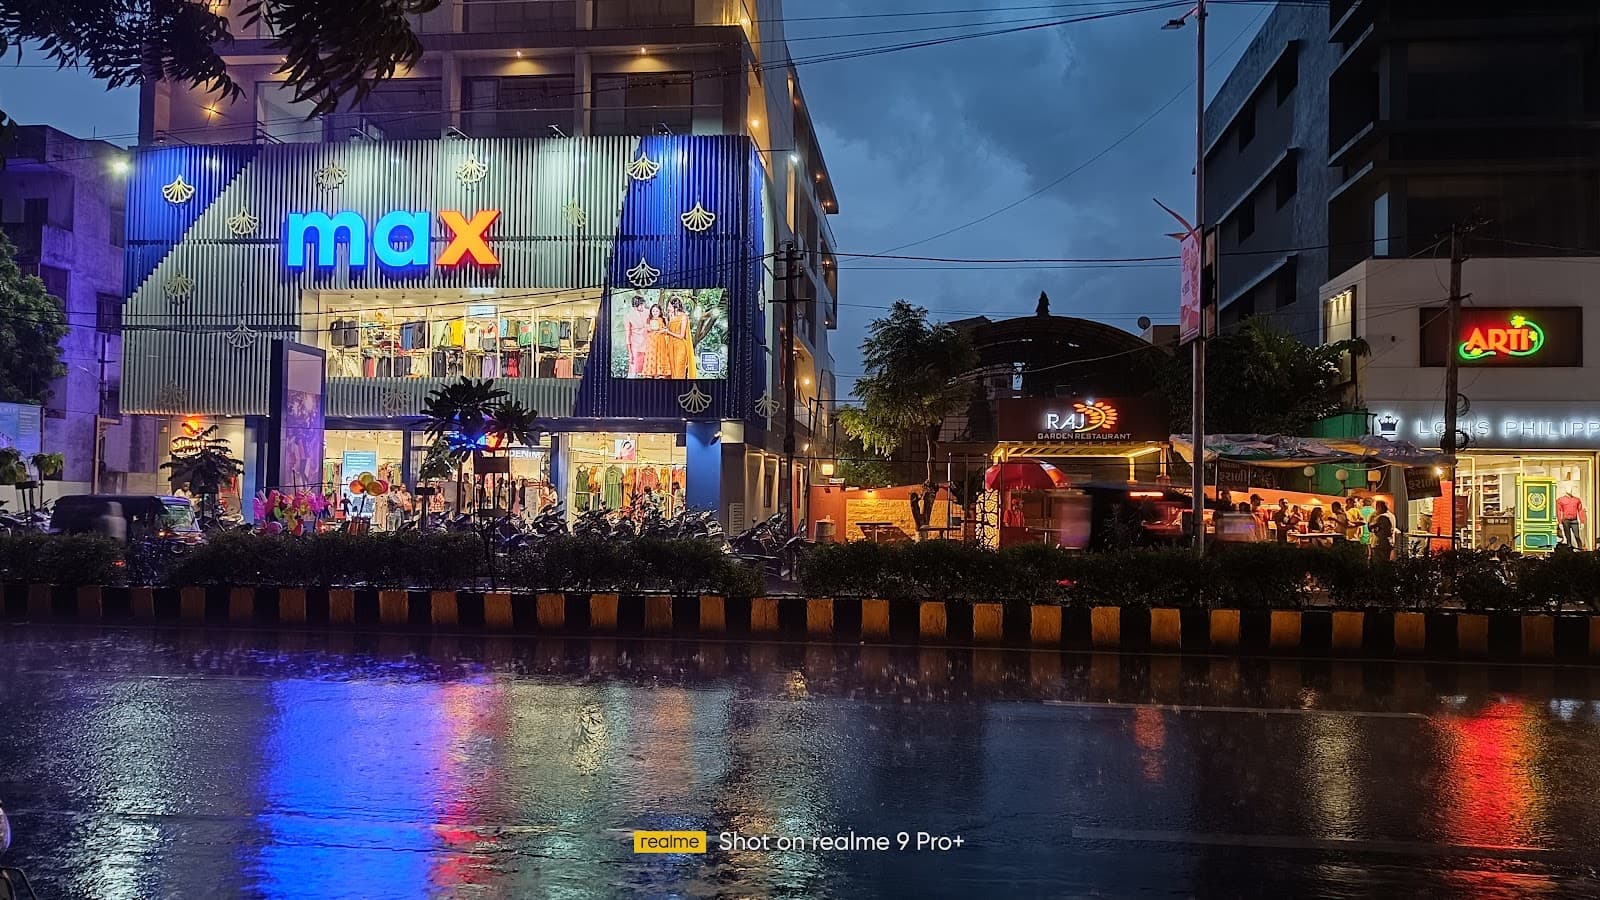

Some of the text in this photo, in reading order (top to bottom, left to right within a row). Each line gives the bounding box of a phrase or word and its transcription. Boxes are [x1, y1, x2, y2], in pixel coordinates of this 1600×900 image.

[286, 209, 501, 268] max
[1464, 327, 1529, 354] ARTI
[1046, 413, 1085, 430] RAJ
[1037, 432, 1073, 440] GARDEN
[509, 449, 543, 458] DENIM
